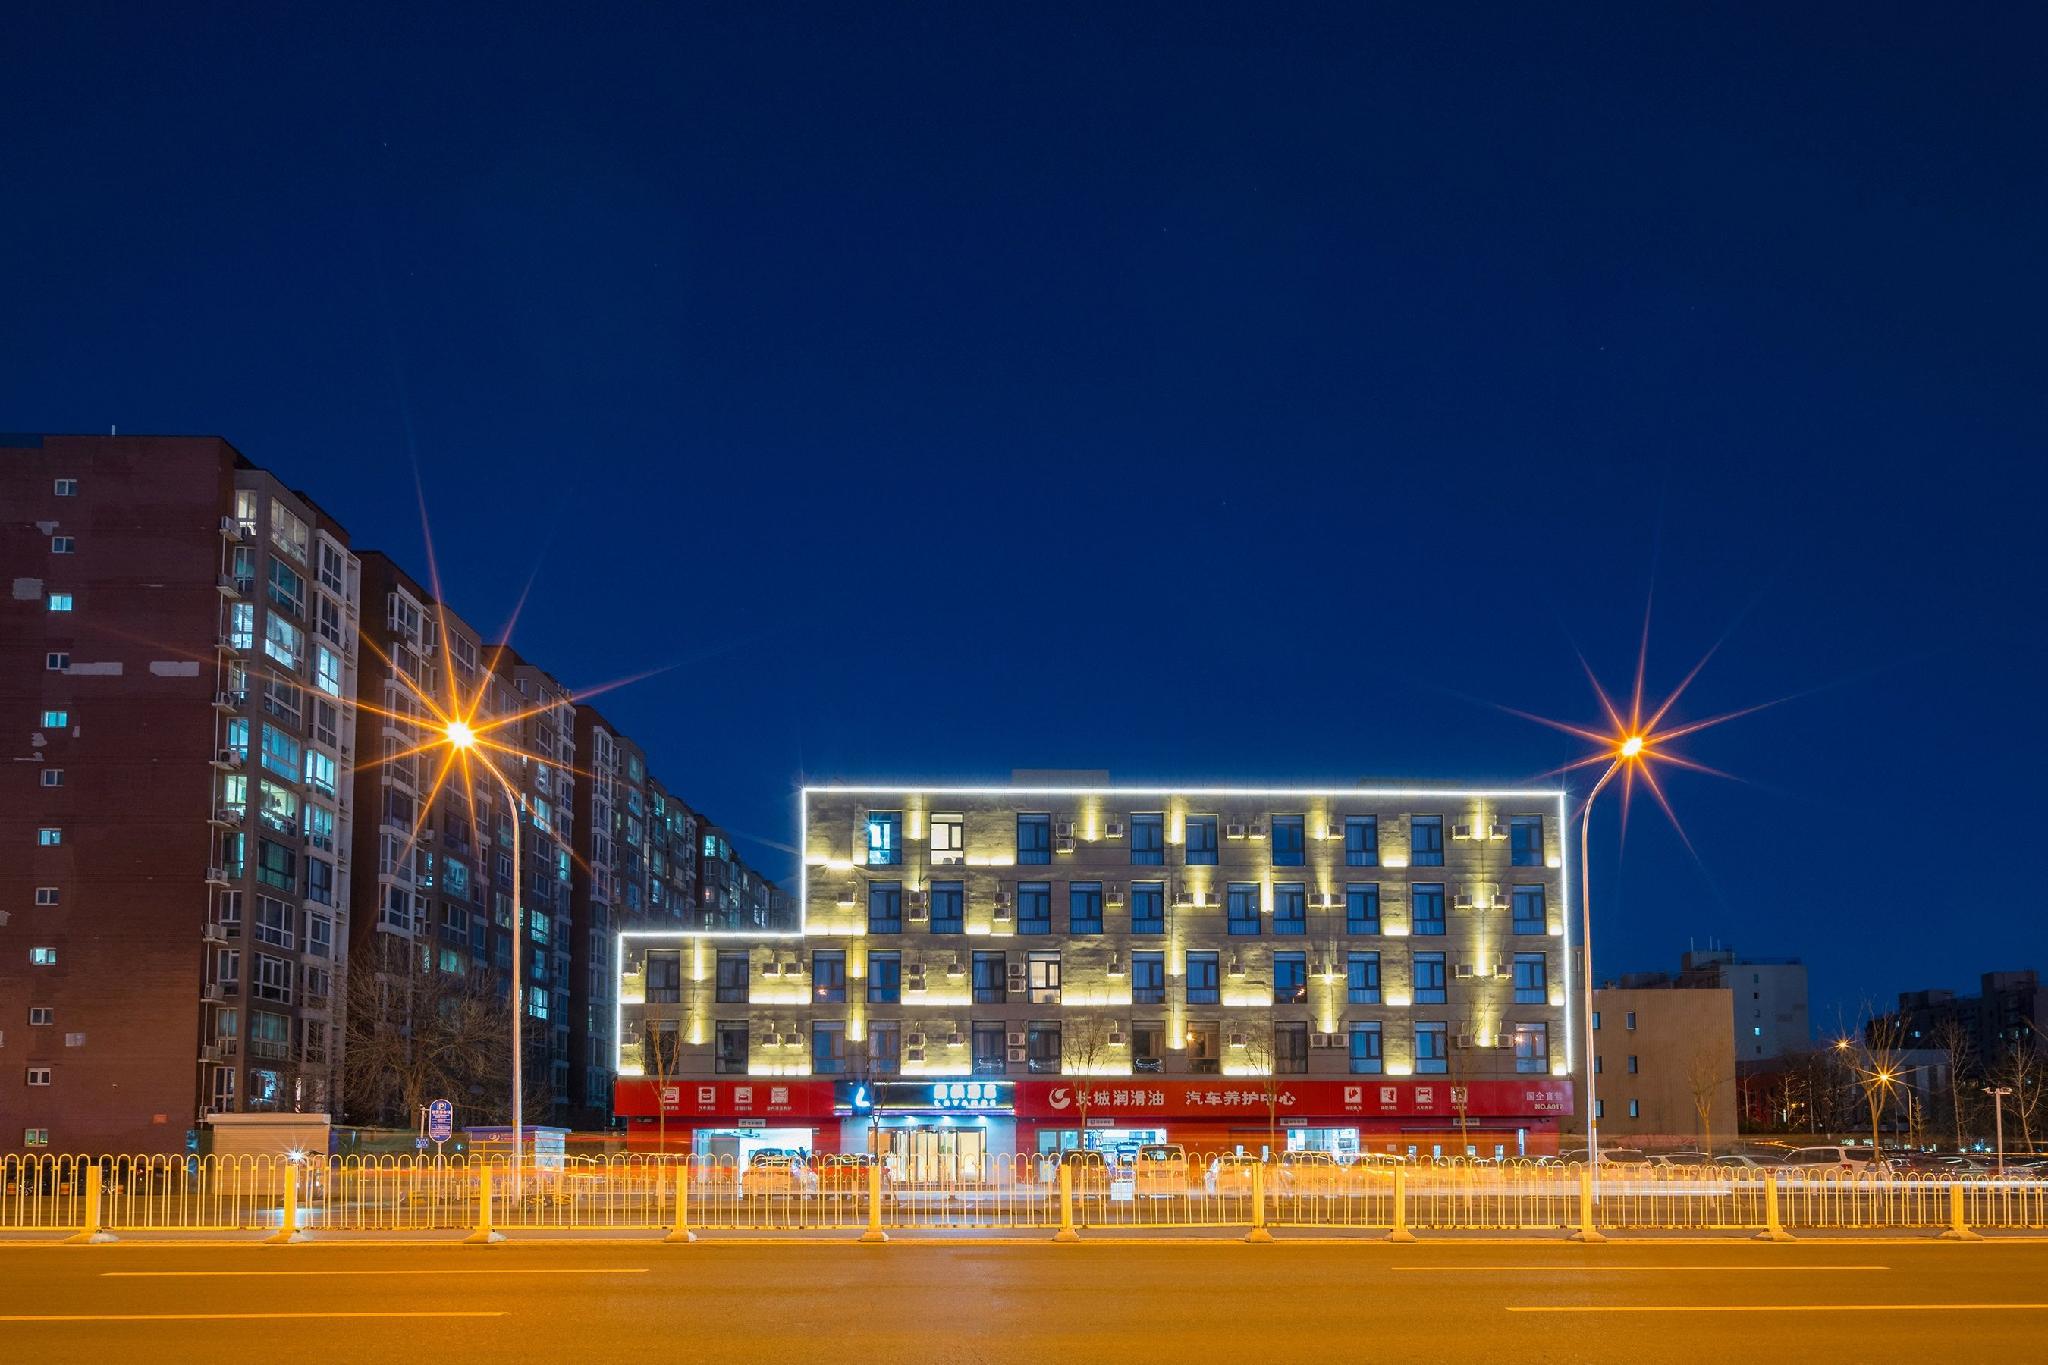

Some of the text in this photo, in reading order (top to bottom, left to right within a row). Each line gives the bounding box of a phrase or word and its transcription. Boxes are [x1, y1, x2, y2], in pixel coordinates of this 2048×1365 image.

[1076, 1090, 1165, 1106] 长城润滑油
[1185, 1090, 1297, 1106] 汽车养护中心
